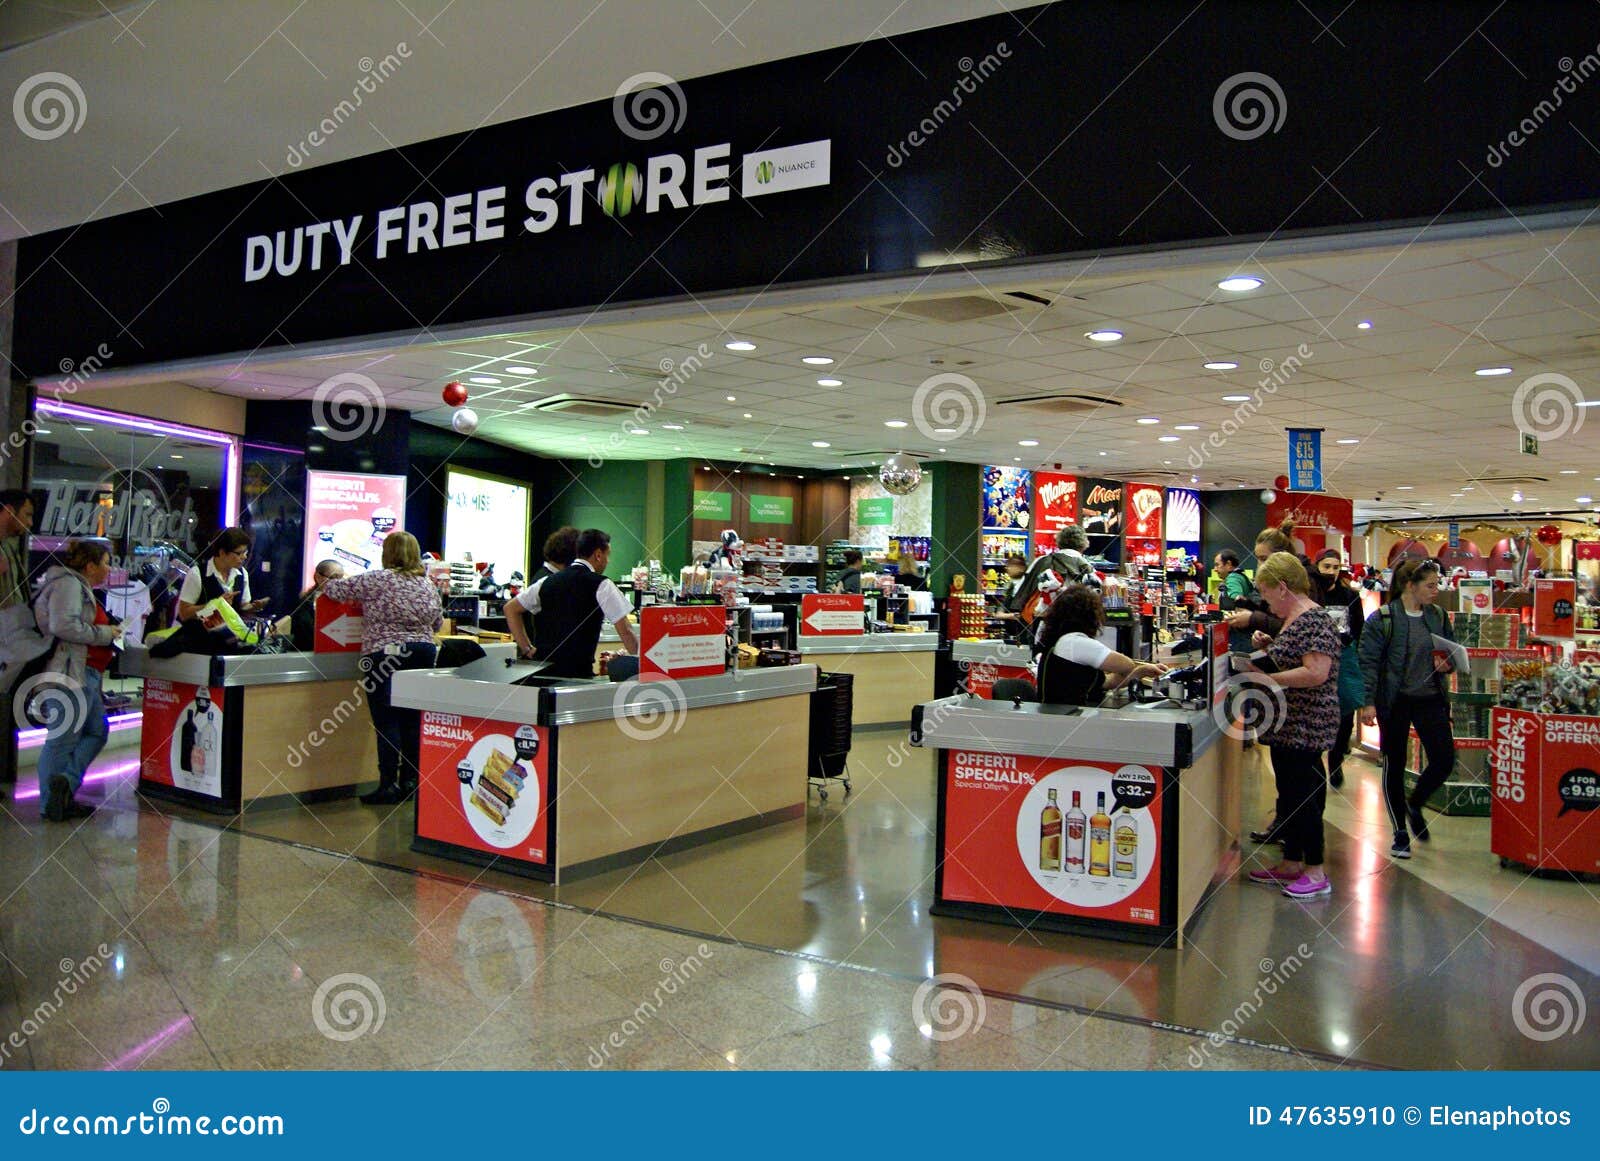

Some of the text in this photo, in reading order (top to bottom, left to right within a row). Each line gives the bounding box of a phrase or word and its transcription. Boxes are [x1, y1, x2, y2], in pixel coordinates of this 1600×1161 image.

[778, 158, 816, 174] NUANCE
[245, 215, 362, 282] DUTY
[376, 186, 506, 259] FREE
[40, 482, 199, 553] Hard Rock
[423, 711, 462, 728] OFFERTI
[1545, 720, 1600, 733] SPECIA
[423, 723, 474, 742] SPECIALI%
[955, 752, 1017, 769] OFFERTI
[1496, 712, 1511, 800] SPECIAL
[1511, 716, 1526, 803] OFFER%
[955, 766, 1036, 785] SPECIALI%
[1577, 776, 1595, 784] FOR
[955, 780, 982, 790] Special
